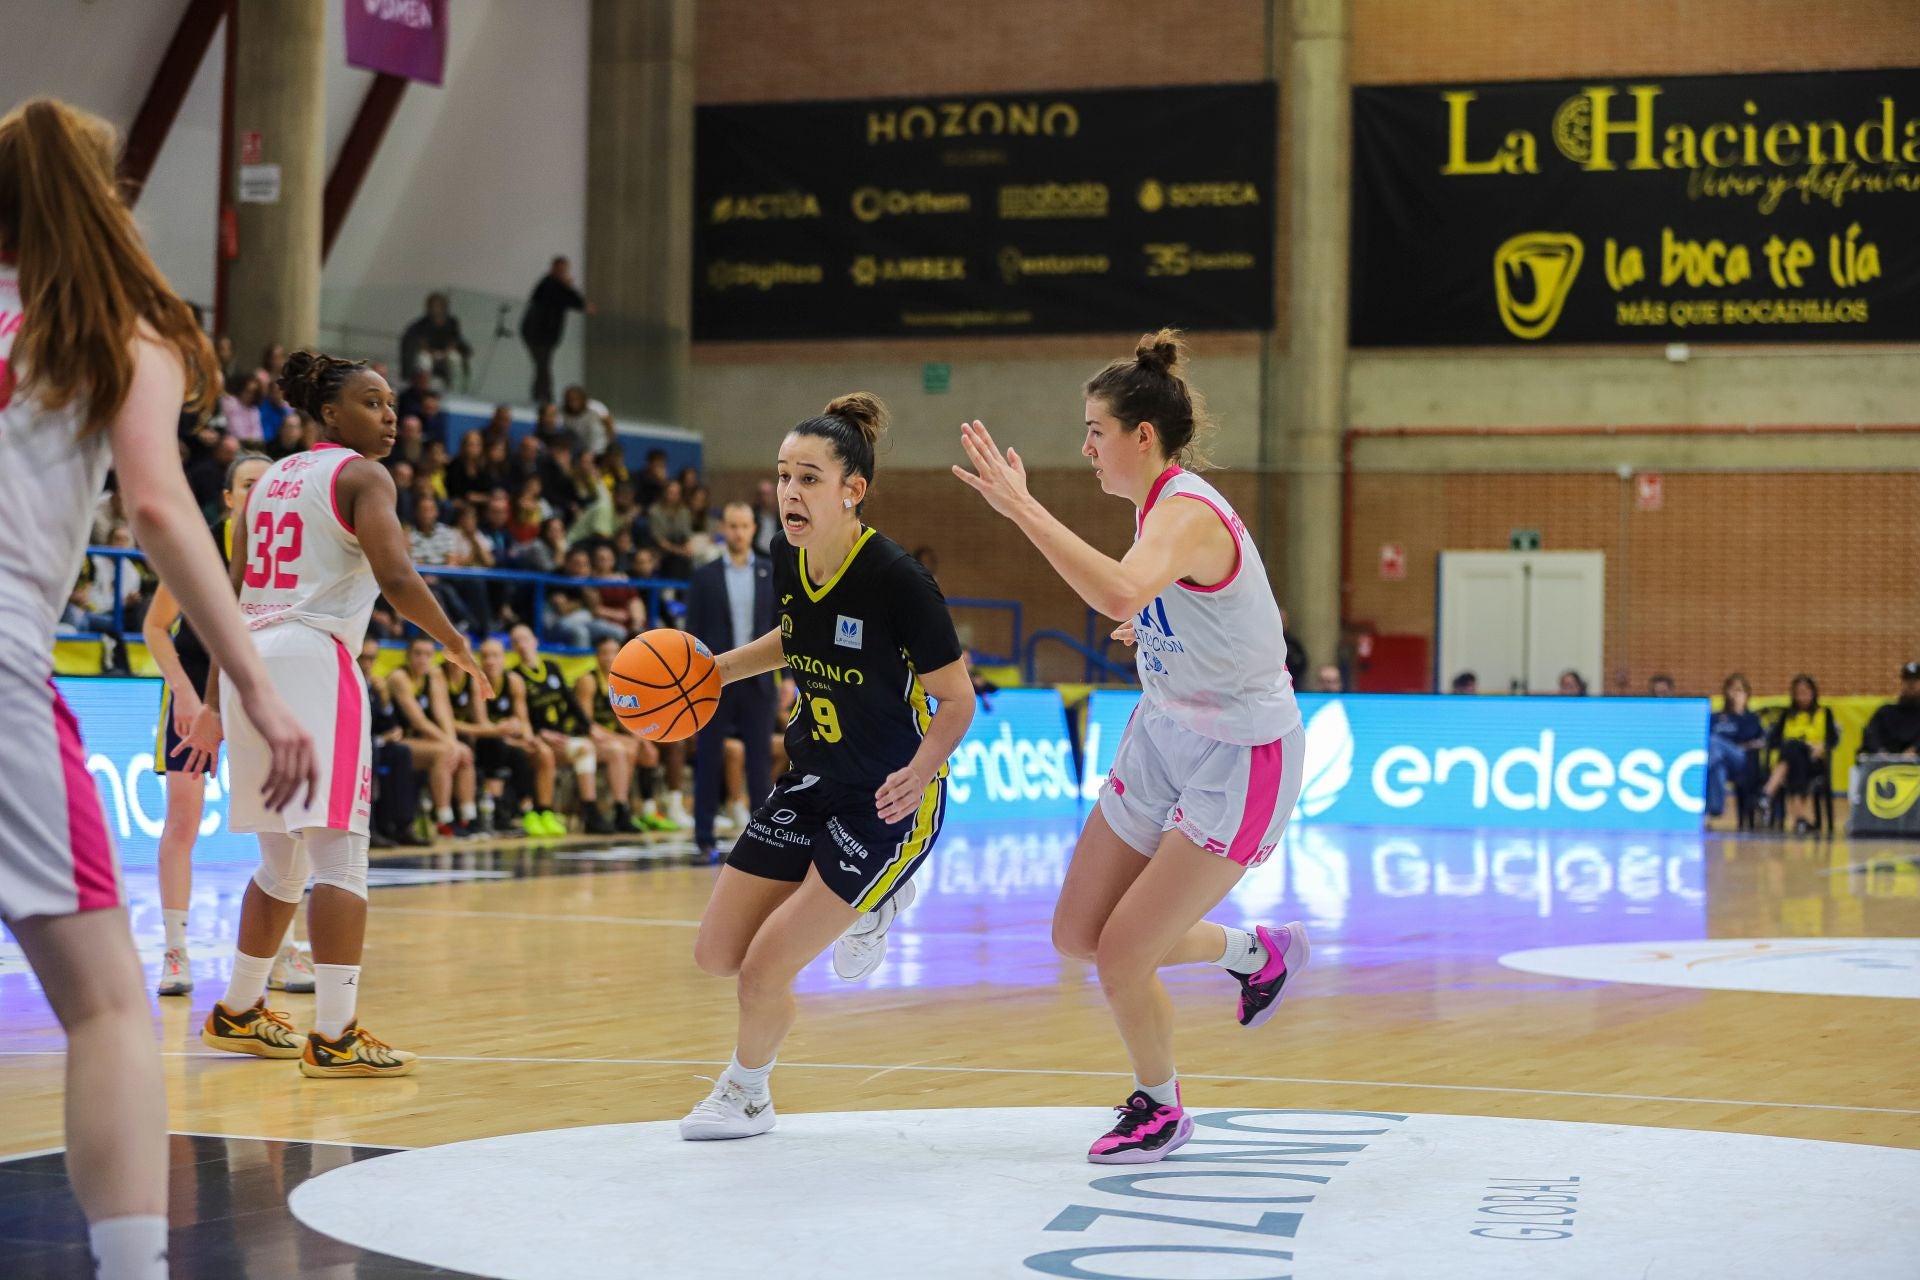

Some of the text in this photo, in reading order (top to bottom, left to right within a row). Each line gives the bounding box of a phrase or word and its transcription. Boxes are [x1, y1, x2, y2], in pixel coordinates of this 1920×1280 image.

[866, 101, 1080, 144] HOZONO
[1441, 91, 1540, 175] La
[1604, 238, 1644, 291] la
[1660, 227, 1751, 288] boca
[1763, 234, 1815, 288] te
[1670, 299, 1719, 327] QUE
[1723, 297, 1869, 324] BOCADILLOS
[244, 511, 304, 590] 32
[774, 828, 812, 846] Cálida
[1469, 1176, 1580, 1241] GLOBAL
